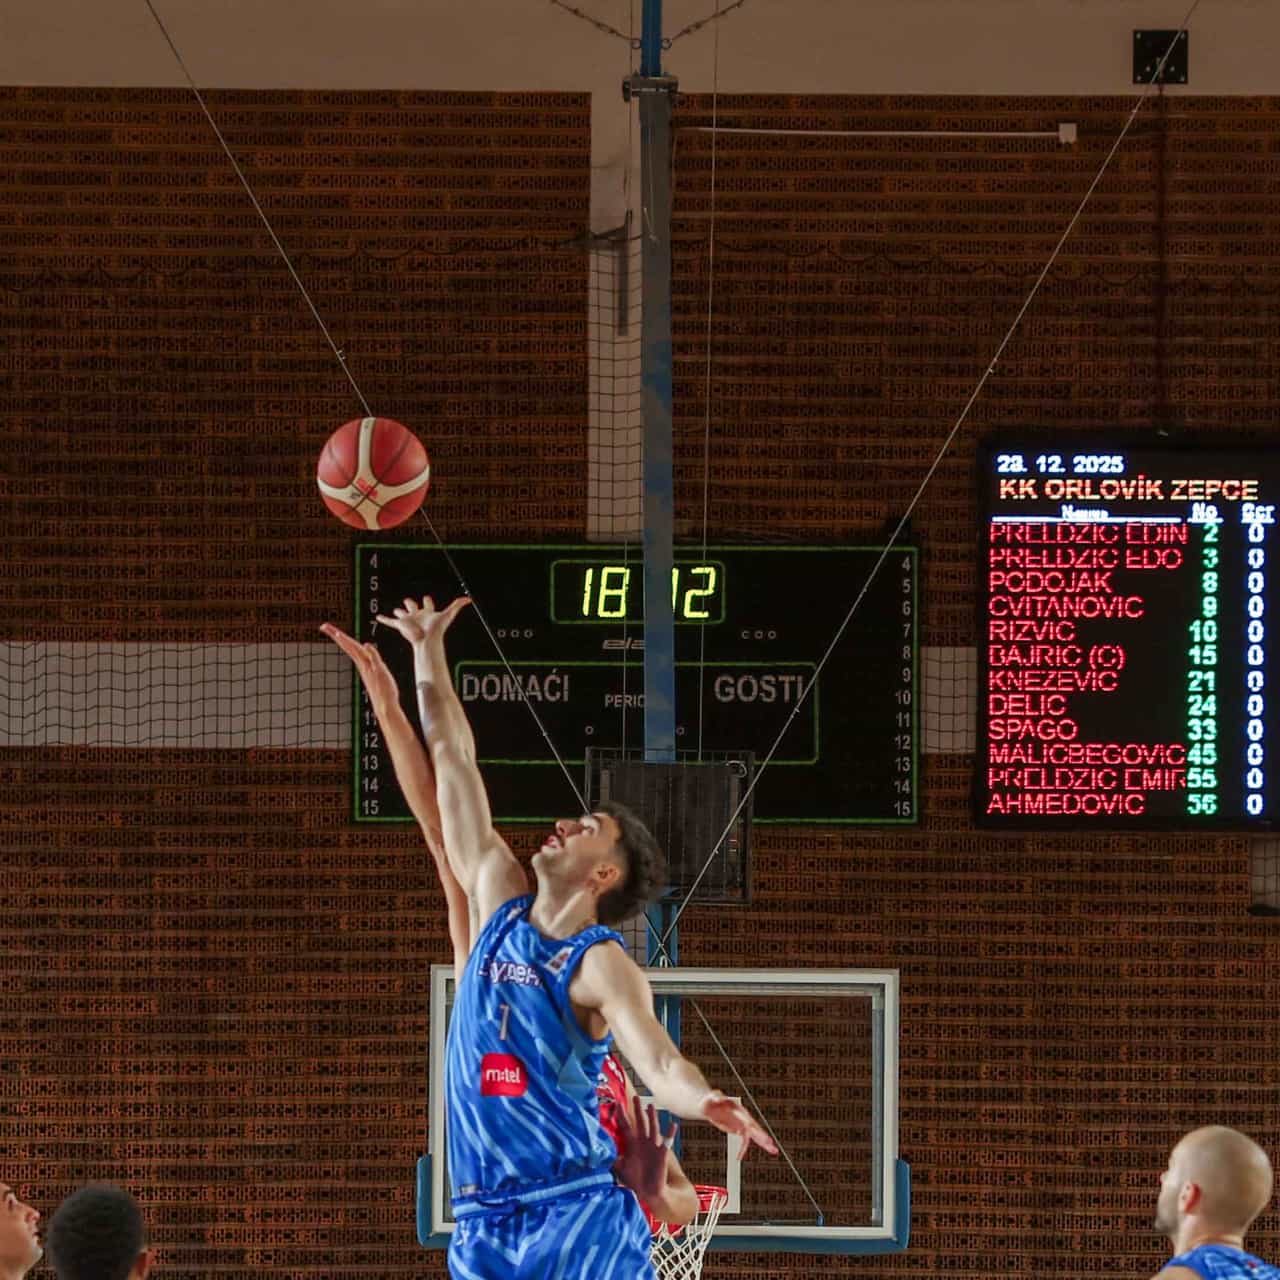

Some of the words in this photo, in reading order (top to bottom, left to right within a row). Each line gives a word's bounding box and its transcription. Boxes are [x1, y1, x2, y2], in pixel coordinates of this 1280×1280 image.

[1036, 455, 1066, 473] 12.
[1073, 455, 1124, 473] 2025
[1000, 479, 1037, 500] KK
[1170, 479, 1258, 500] ZEPCE
[1192, 502, 1219, 519] No
[1204, 524, 1218, 542] 2
[1248, 524, 1264, 543] 0
[902, 556, 911, 570] 4
[1126, 549, 1182, 568] EDO
[1203, 548, 1218, 568] 3
[370, 576, 378, 590] 5
[902, 579, 911, 592] 5
[989, 572, 1112, 592] PODOJAK
[1203, 572, 1218, 593] 8
[583, 567, 630, 617] 18
[902, 601, 911, 615] 6
[989, 597, 1144, 617] CVITANOVIC
[1248, 595, 1264, 618] 0
[903, 624, 911, 638] 7
[989, 621, 1075, 640] RIZVIC
[1189, 620, 1217, 642] 10
[902, 646, 911, 660] 8
[989, 646, 1082, 665] BAJRIC
[1090, 646, 1125, 667] (C)
[1189, 644, 1217, 665] 15
[902, 668, 911, 682] 9
[989, 672, 1118, 691] KNEZEVIC
[1188, 671, 1215, 691] 21
[1247, 671, 1264, 692] 0
[462, 668, 568, 702] DOMAĆI
[714, 674, 802, 702] GOSTI
[896, 690, 911, 704] 10
[989, 696, 1066, 714] DELIC
[1188, 695, 1216, 716] 24
[896, 712, 910, 727] 11
[989, 720, 1077, 740] SPAGO
[1188, 718, 1216, 740] 33
[364, 734, 378, 748] 12
[894, 735, 911, 750] 12
[1188, 743, 1217, 765] 45
[1247, 743, 1263, 765] 0
[362, 756, 378, 770] 13
[894, 757, 911, 771] 13
[362, 778, 378, 792] 14
[894, 779, 911, 794] 14
[1188, 768, 1217, 788] 55
[362, 800, 378, 814] 15
[894, 802, 911, 816] 15
[986, 795, 1144, 814] AHMEDOVIC
[1188, 794, 1217, 814] 56
